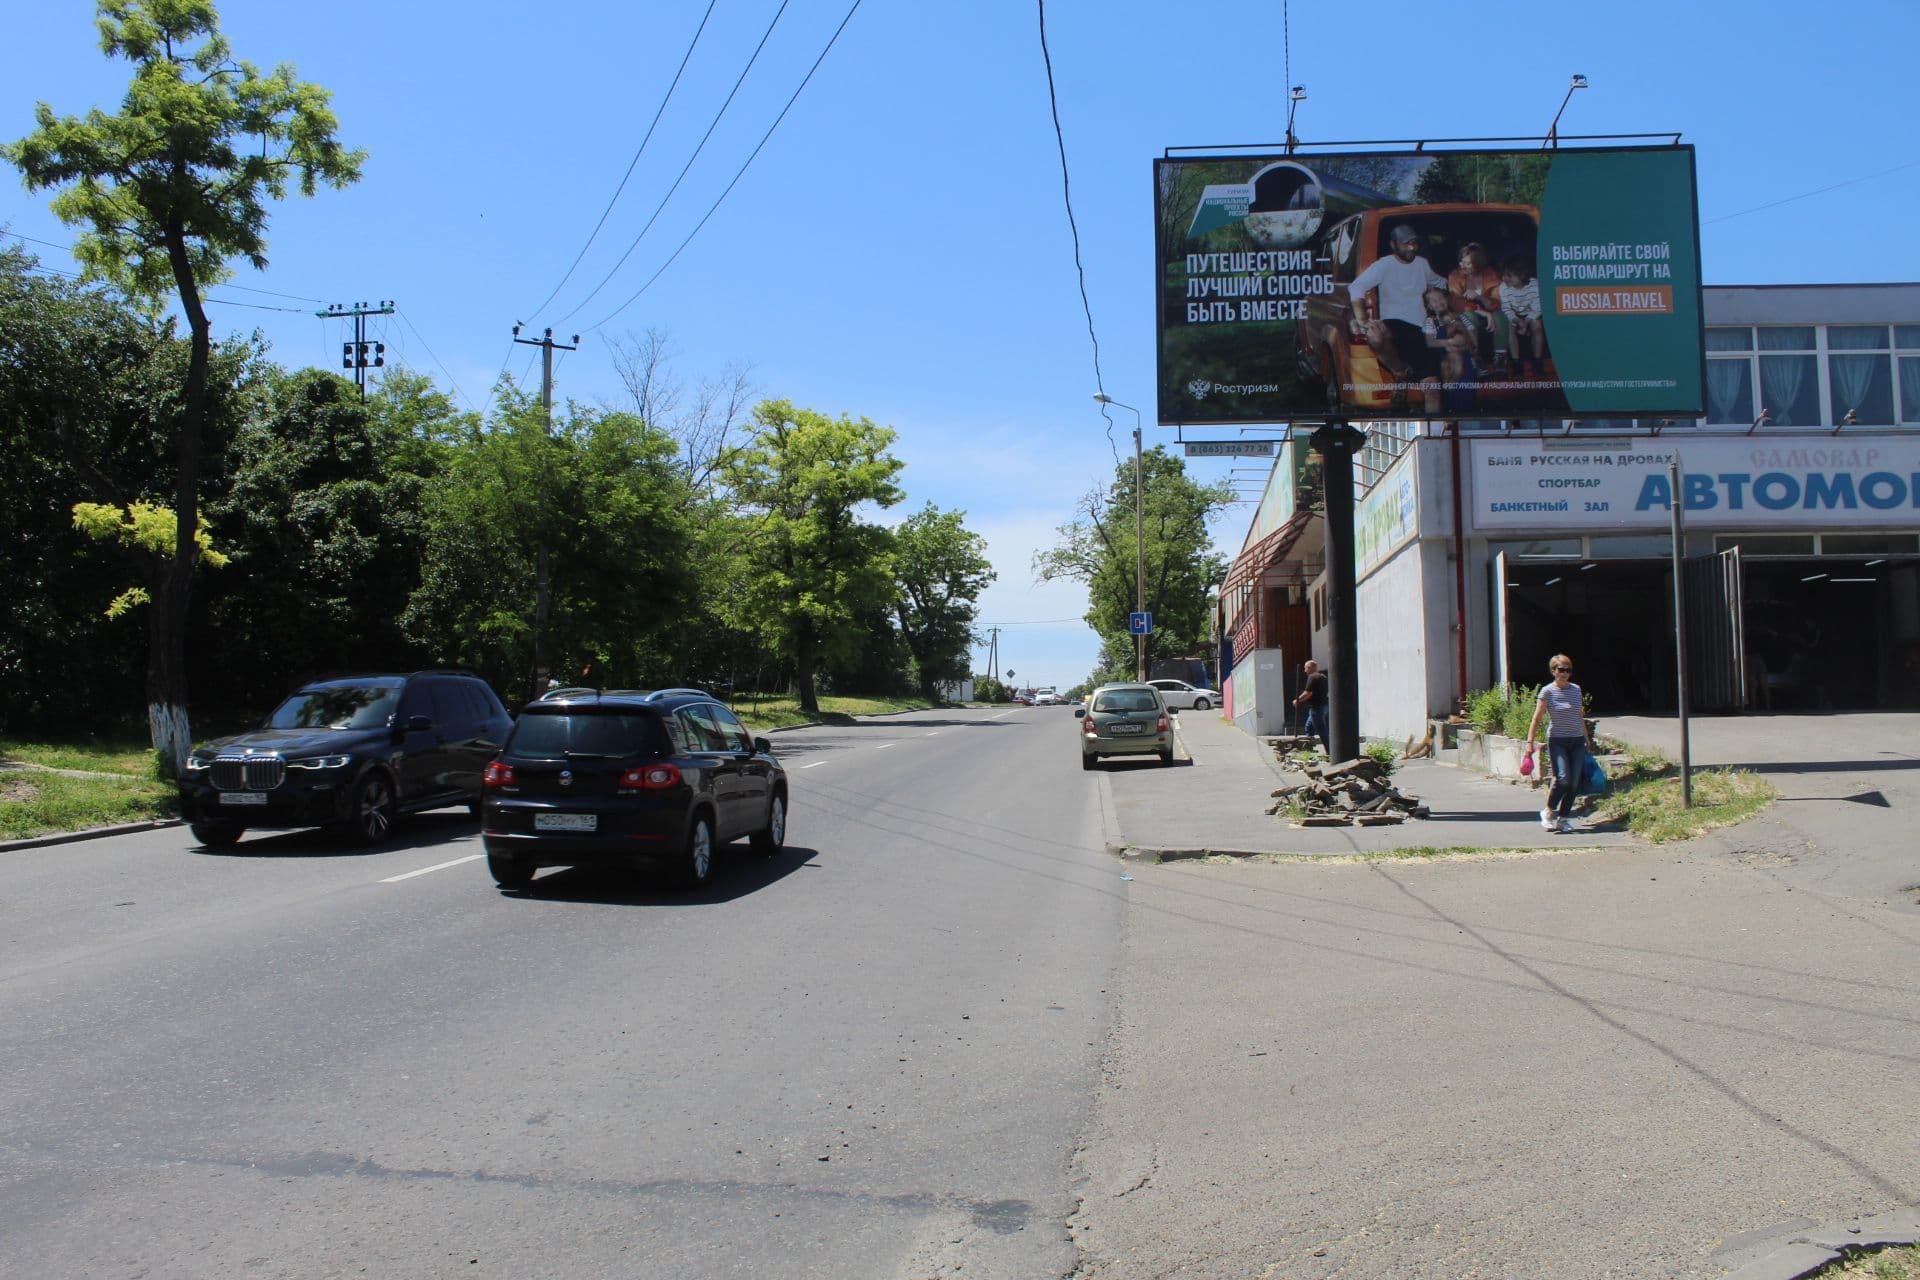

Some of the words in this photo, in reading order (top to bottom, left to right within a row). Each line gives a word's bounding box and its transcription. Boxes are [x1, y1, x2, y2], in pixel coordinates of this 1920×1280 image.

[1553, 243, 1632, 261] ВЫБИРАЙТЕ
[1635, 242, 1670, 260] СВОЙ
[1186, 250, 1312, 274] ПУТЕШЕСТВИЯ
[1554, 264, 1650, 280] АВТОМАРШРУТ
[1653, 264, 1671, 279] НА
[1186, 273, 1263, 298] ЛУЧШИЙ
[1267, 274, 1335, 296] СПОСОБ
[1562, 292, 1666, 310] RUSSIA.TRAVEL
[1187, 302, 1236, 323] БЫТЬ
[1240, 299, 1309, 321] ВМЕСТЕ
[1214, 383, 1278, 397] Ростуризм
[1488, 456, 1522, 466] БАНЯ
[1530, 455, 1590, 466] РУССКАЯ
[1593, 455, 1613, 465] НА
[1616, 455, 1673, 467] ДРОВАХ
[1538, 478, 1601, 489] СПОРТБАР
[1635, 471, 1920, 511] АВТОМО
[1490, 500, 1569, 513] БАНКЕТНЫЙ
[1584, 502, 1609, 512] ЗАЛ
